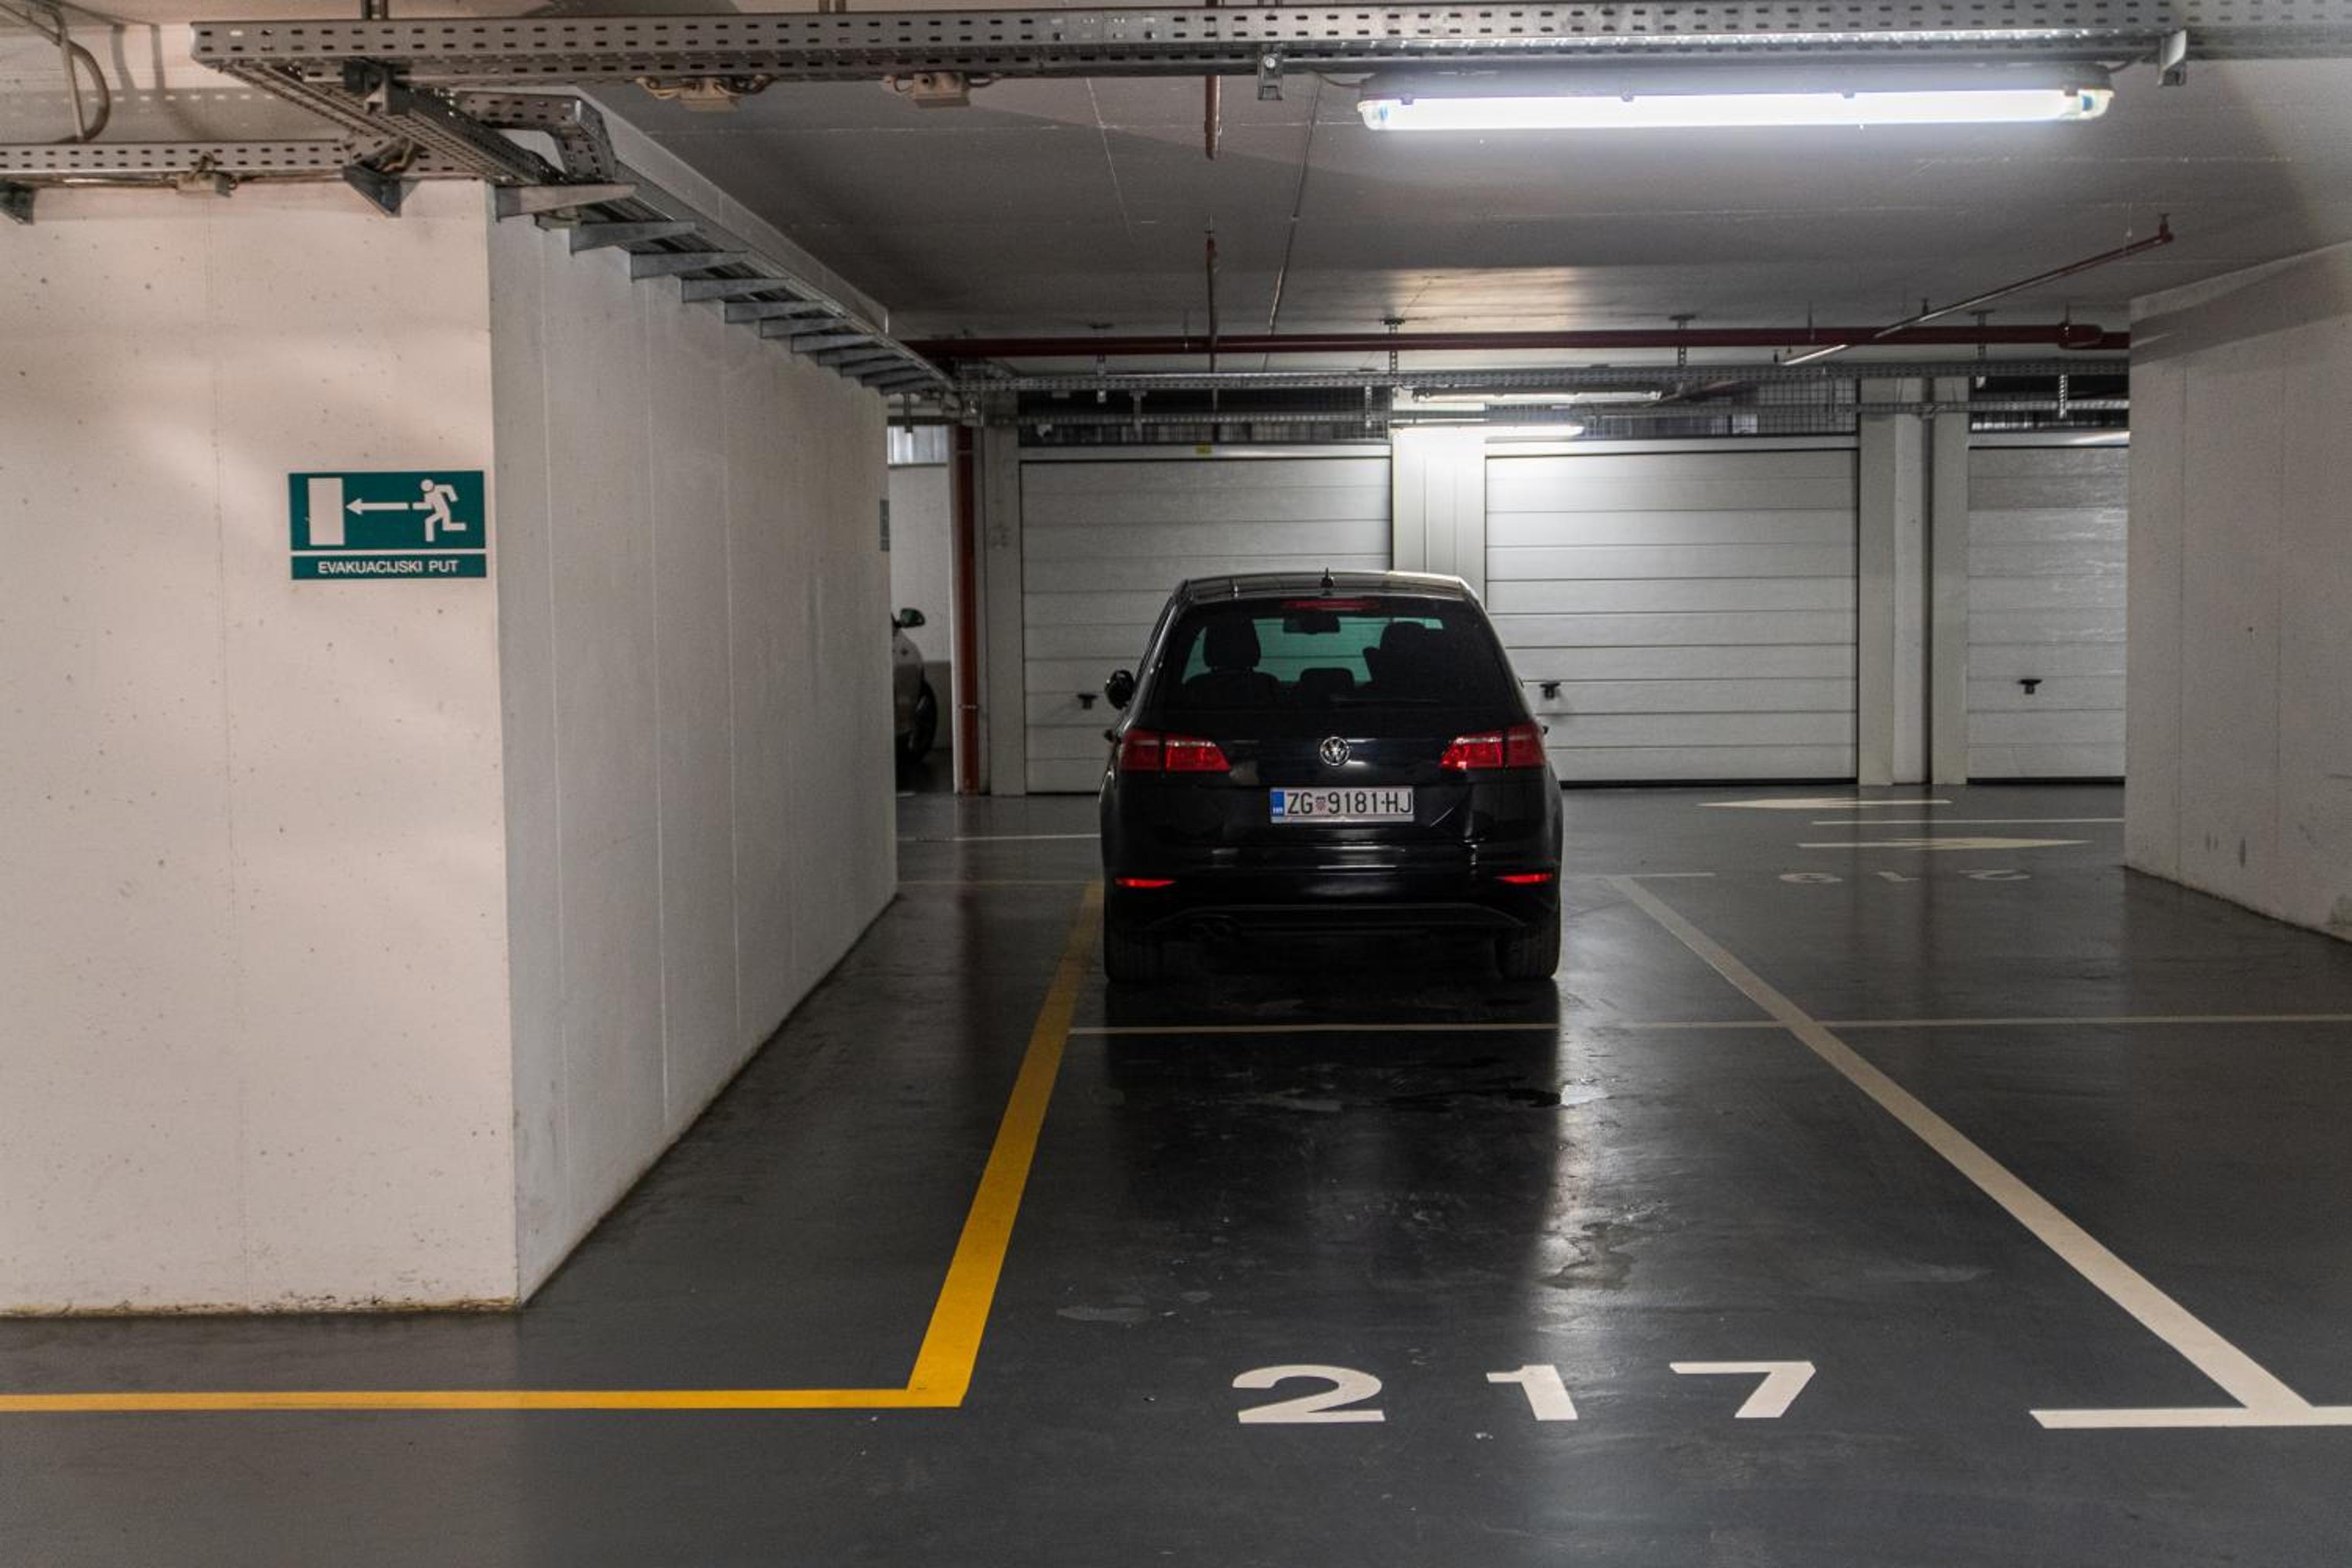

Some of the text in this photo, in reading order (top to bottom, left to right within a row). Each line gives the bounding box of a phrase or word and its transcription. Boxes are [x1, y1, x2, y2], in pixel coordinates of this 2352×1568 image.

[318, 559, 459, 574] EVAKUACIJSKI PUT
[1232, 1360, 1817, 1423] 217
